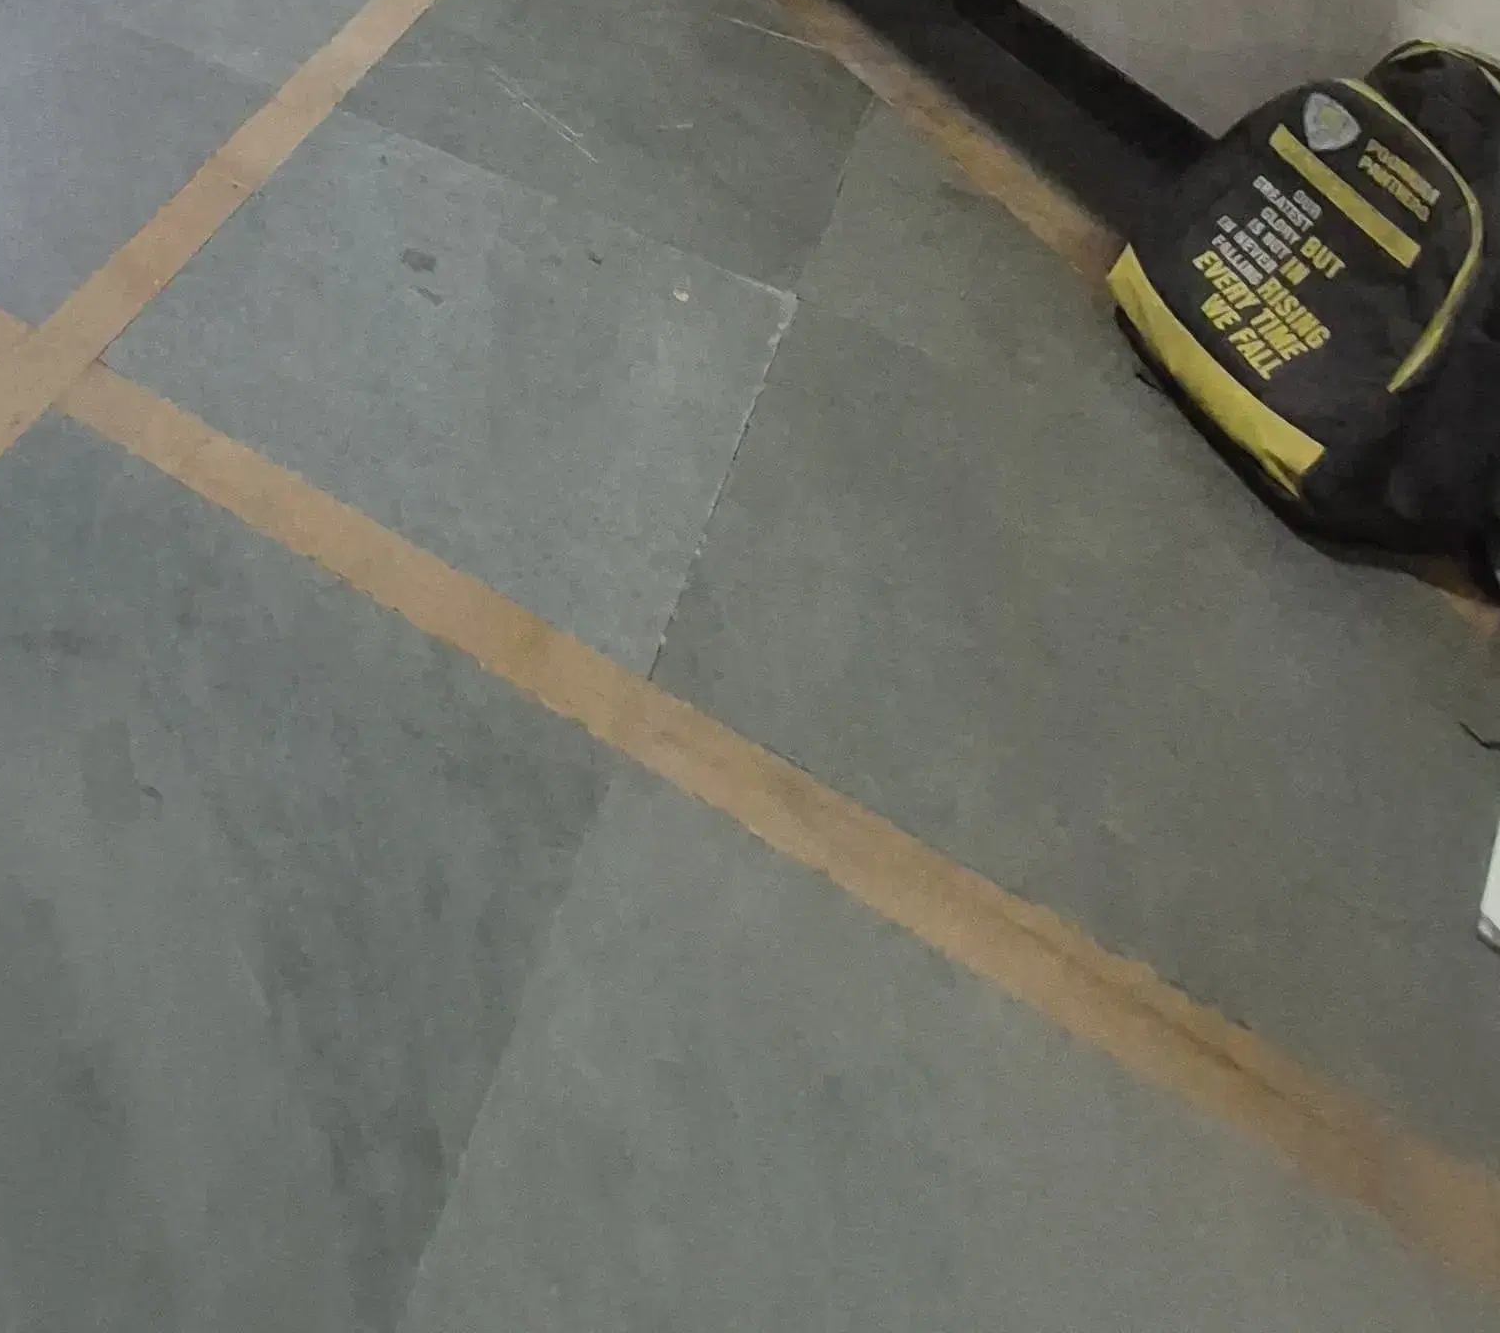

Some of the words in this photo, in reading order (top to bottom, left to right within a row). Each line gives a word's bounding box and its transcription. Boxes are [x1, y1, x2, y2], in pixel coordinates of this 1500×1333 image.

[1280, 257, 1310, 284] IN
[1301, 237, 1344, 277] BUT
[1193, 251, 1260, 309] EVERY
[1251, 308, 1307, 360] TIME
[1202, 293, 1241, 329] WE
[1229, 328, 1281, 379] FALL
[1258, 278, 1329, 348] RISING
